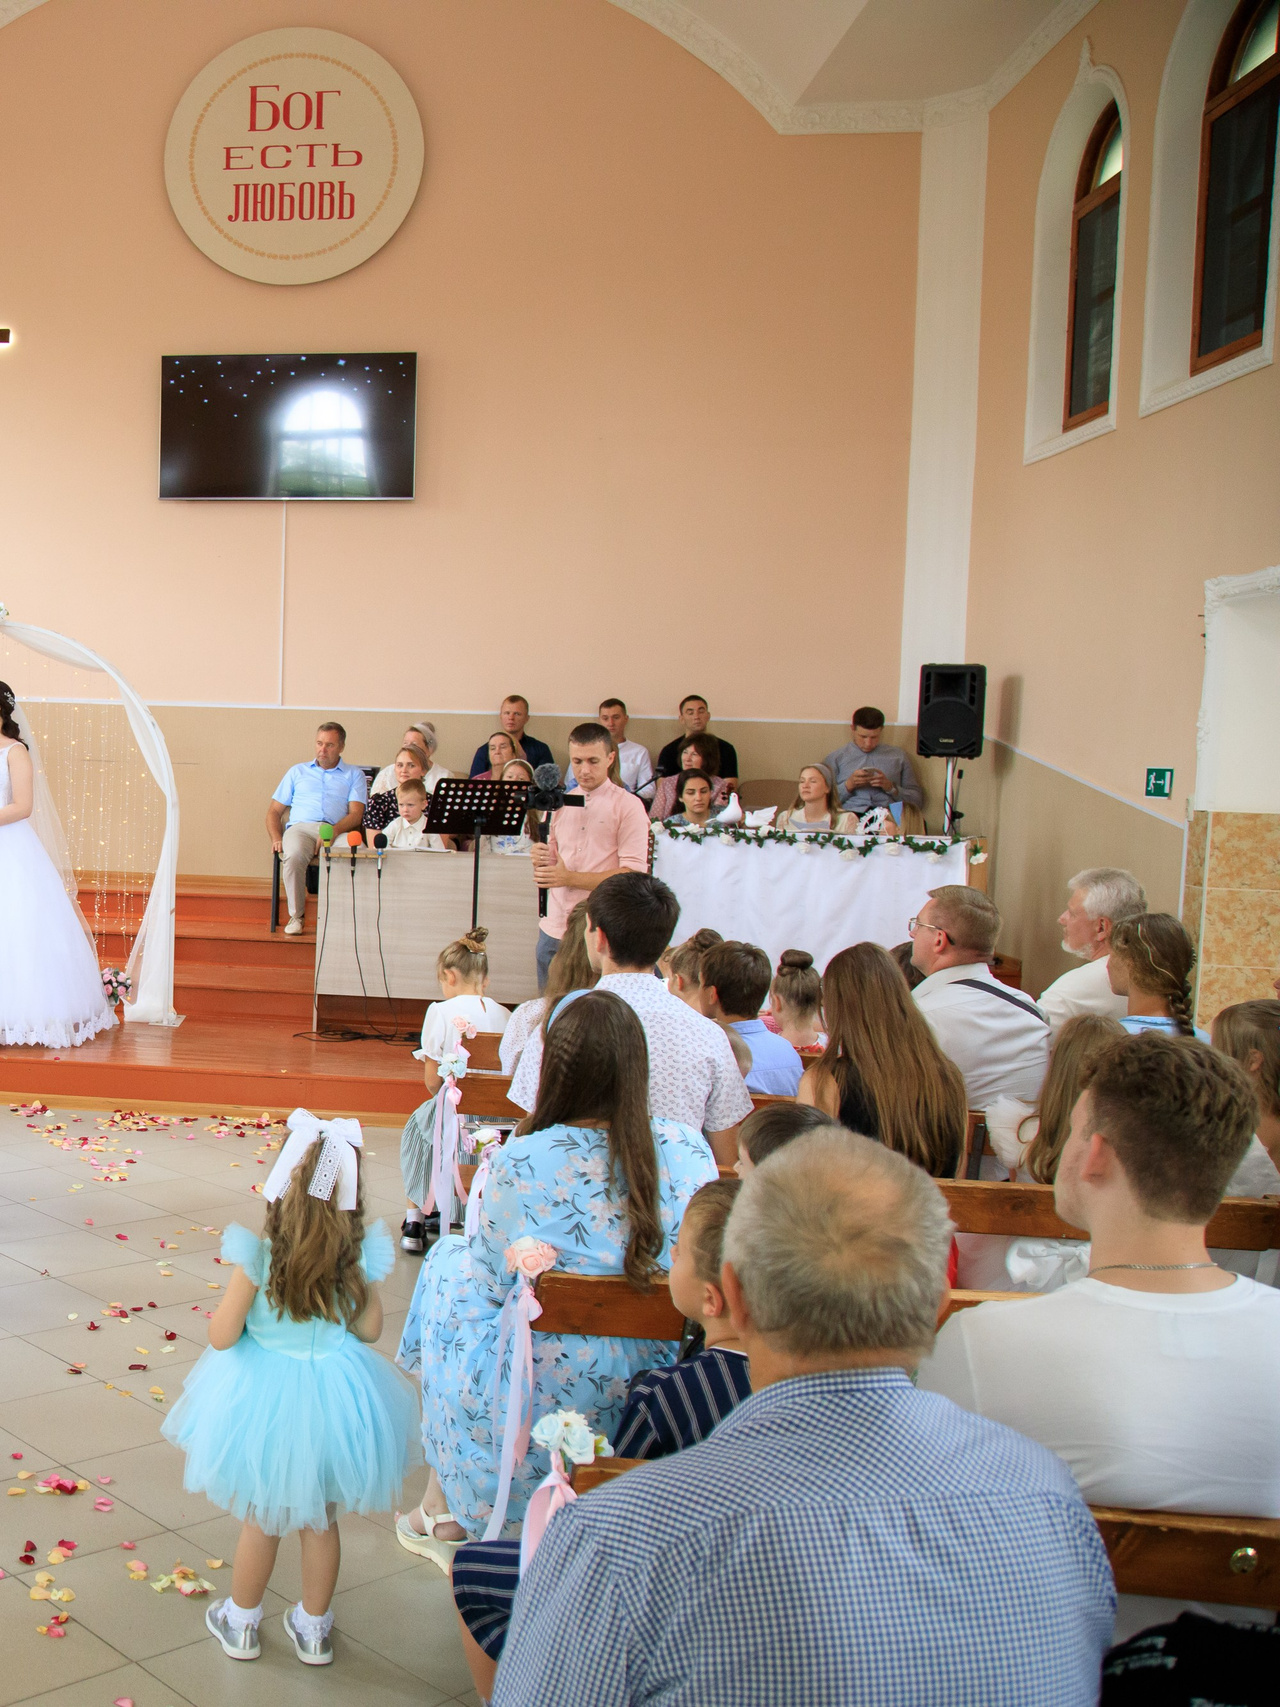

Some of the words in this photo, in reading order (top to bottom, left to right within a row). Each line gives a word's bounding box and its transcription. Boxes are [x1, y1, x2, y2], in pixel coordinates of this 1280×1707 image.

[247, 84, 341, 132] БОГ
[222, 143, 363, 170] ЕСТЬ
[227, 180, 355, 222] ЛЮБОВЬ
